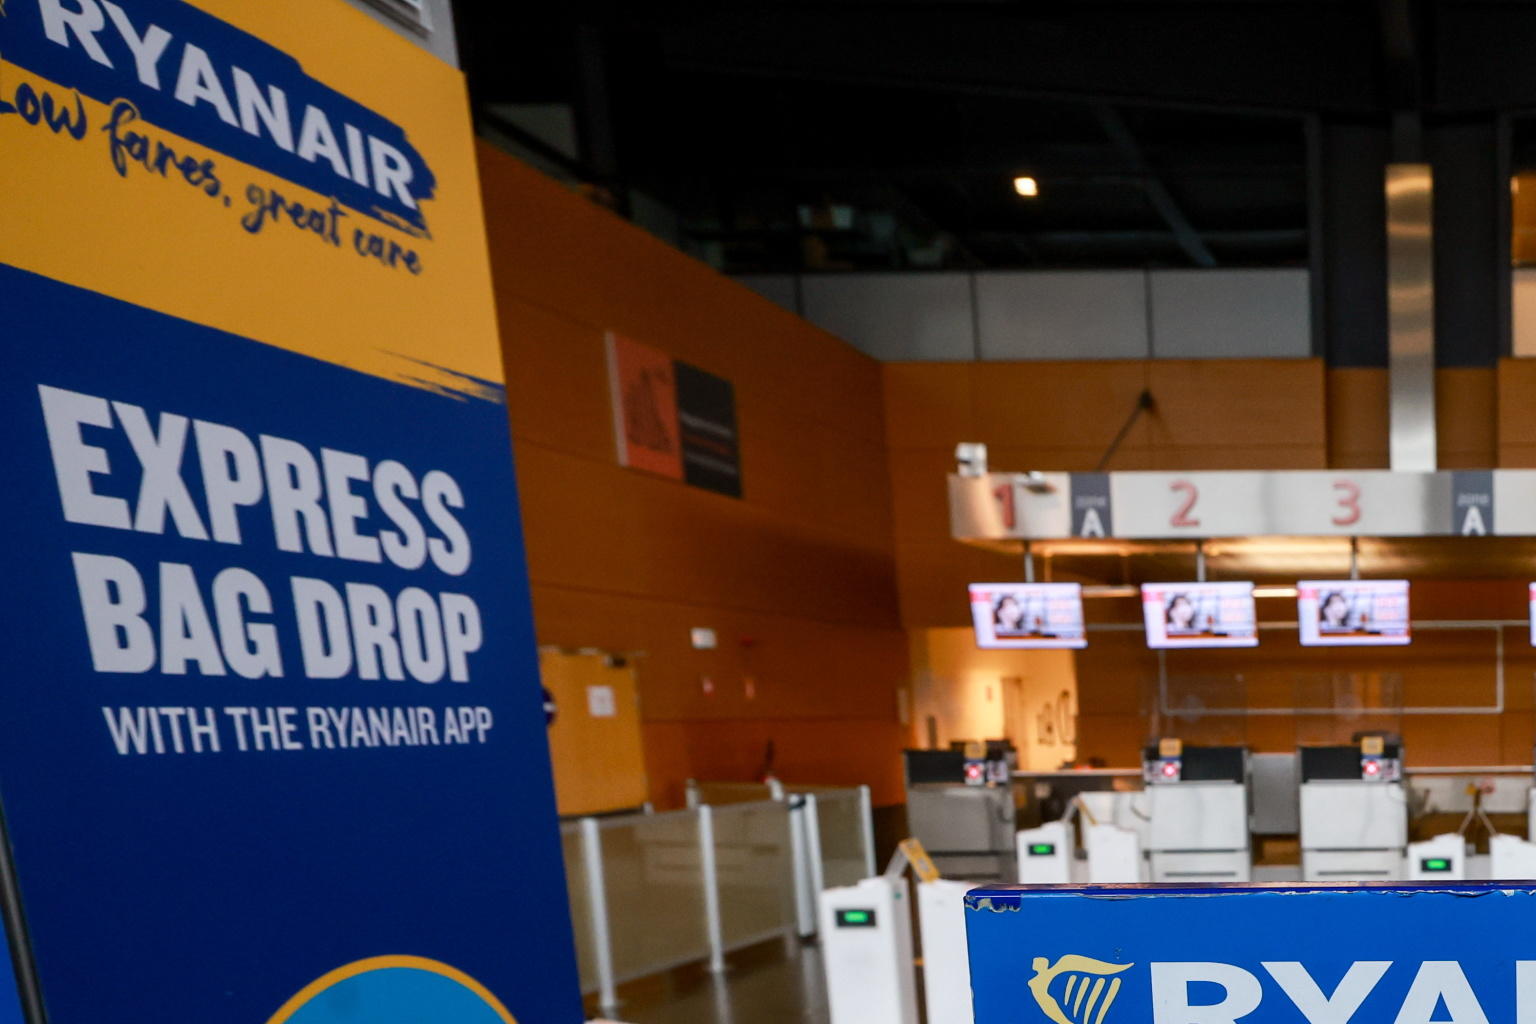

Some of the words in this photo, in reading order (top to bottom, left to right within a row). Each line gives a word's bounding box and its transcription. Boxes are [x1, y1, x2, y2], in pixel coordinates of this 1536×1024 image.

[41, 0, 419, 210] RYANAIR
[242, 183, 348, 246] great
[353, 224, 422, 274] care
[37, 384, 471, 576] EXPRESS
[1168, 480, 1201, 528] 2
[1331, 480, 1362, 527] 3
[992, 482, 1015, 530] 1
[1080, 507, 1106, 538] A
[1461, 505, 1487, 537] A
[72, 551, 284, 680] BAG
[290, 575, 482, 683] DROP
[102, 706, 220, 754] WITH
[223, 706, 303, 751] THE
[306, 706, 440, 748] RYANAIR
[444, 706, 493, 744] APP
